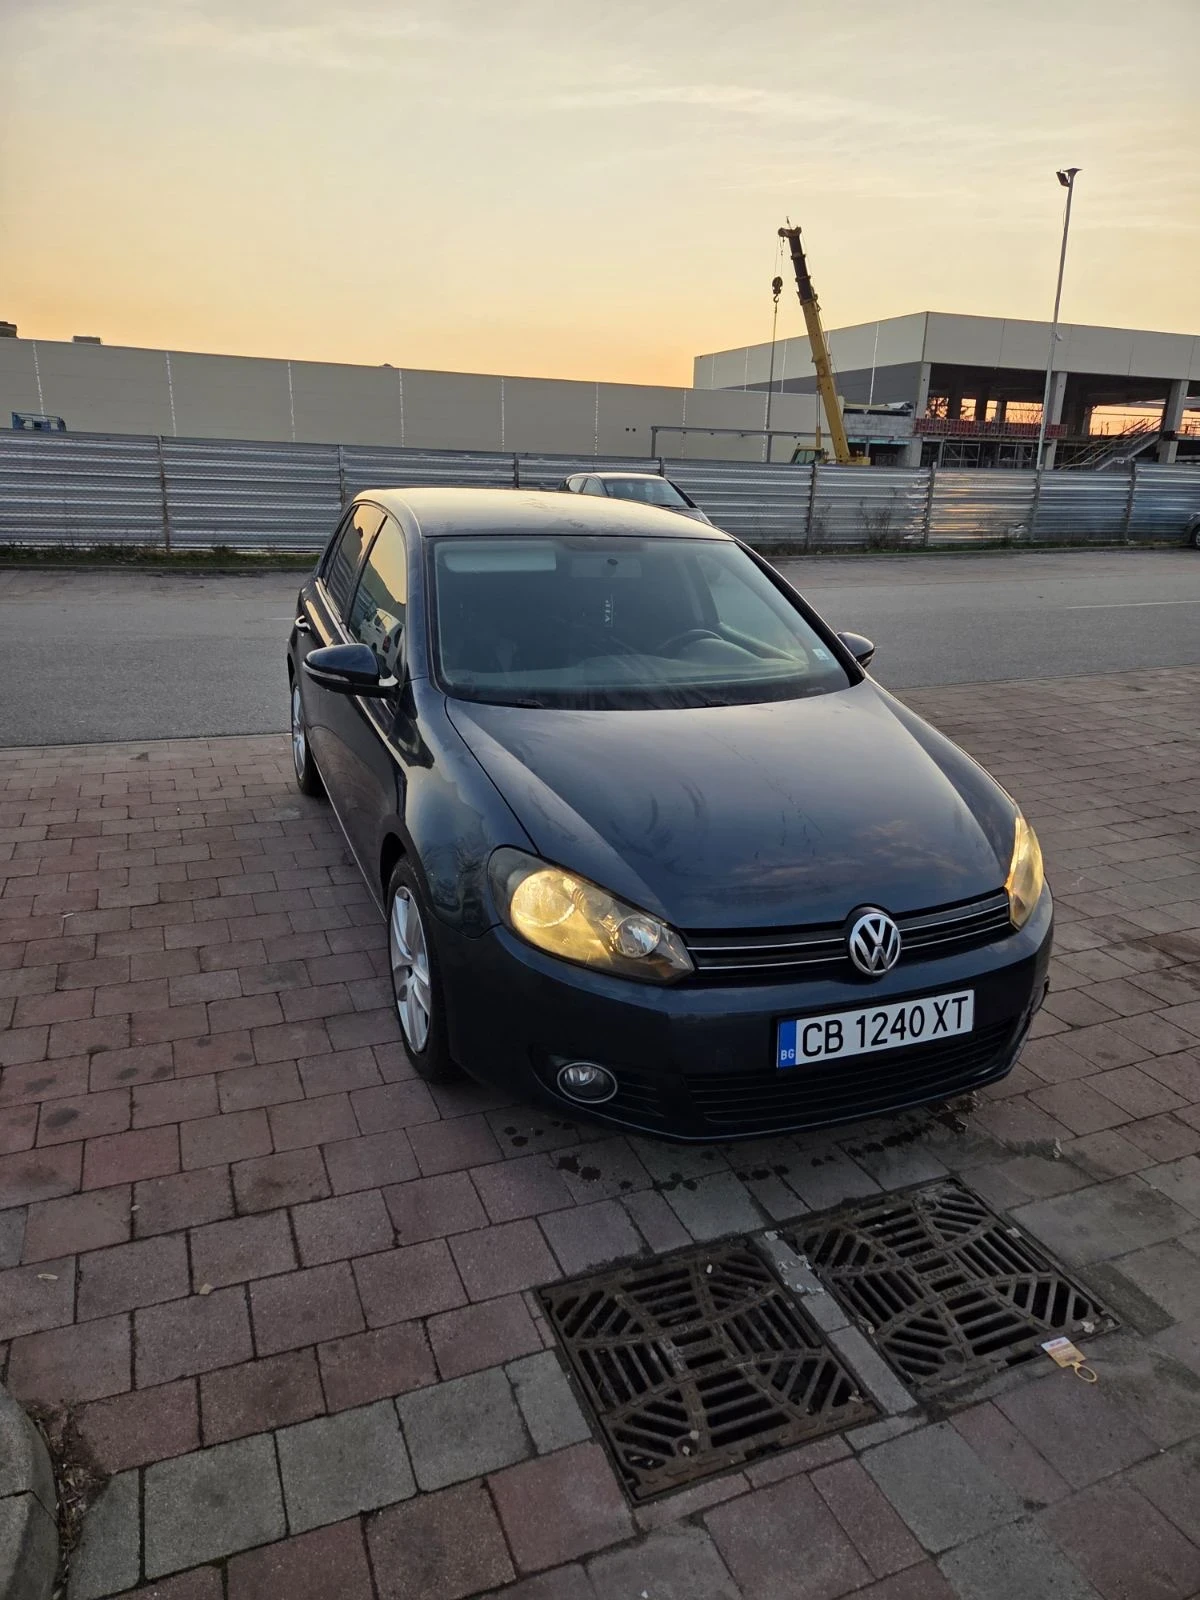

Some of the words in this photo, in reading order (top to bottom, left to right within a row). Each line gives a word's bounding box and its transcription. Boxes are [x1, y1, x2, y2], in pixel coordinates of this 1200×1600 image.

[851, 914, 900, 975] VW
[780, 1048, 795, 1061] BG
[802, 1019, 844, 1057] CB
[855, 1005, 925, 1048] 1240
[932, 996, 968, 1034] XT
